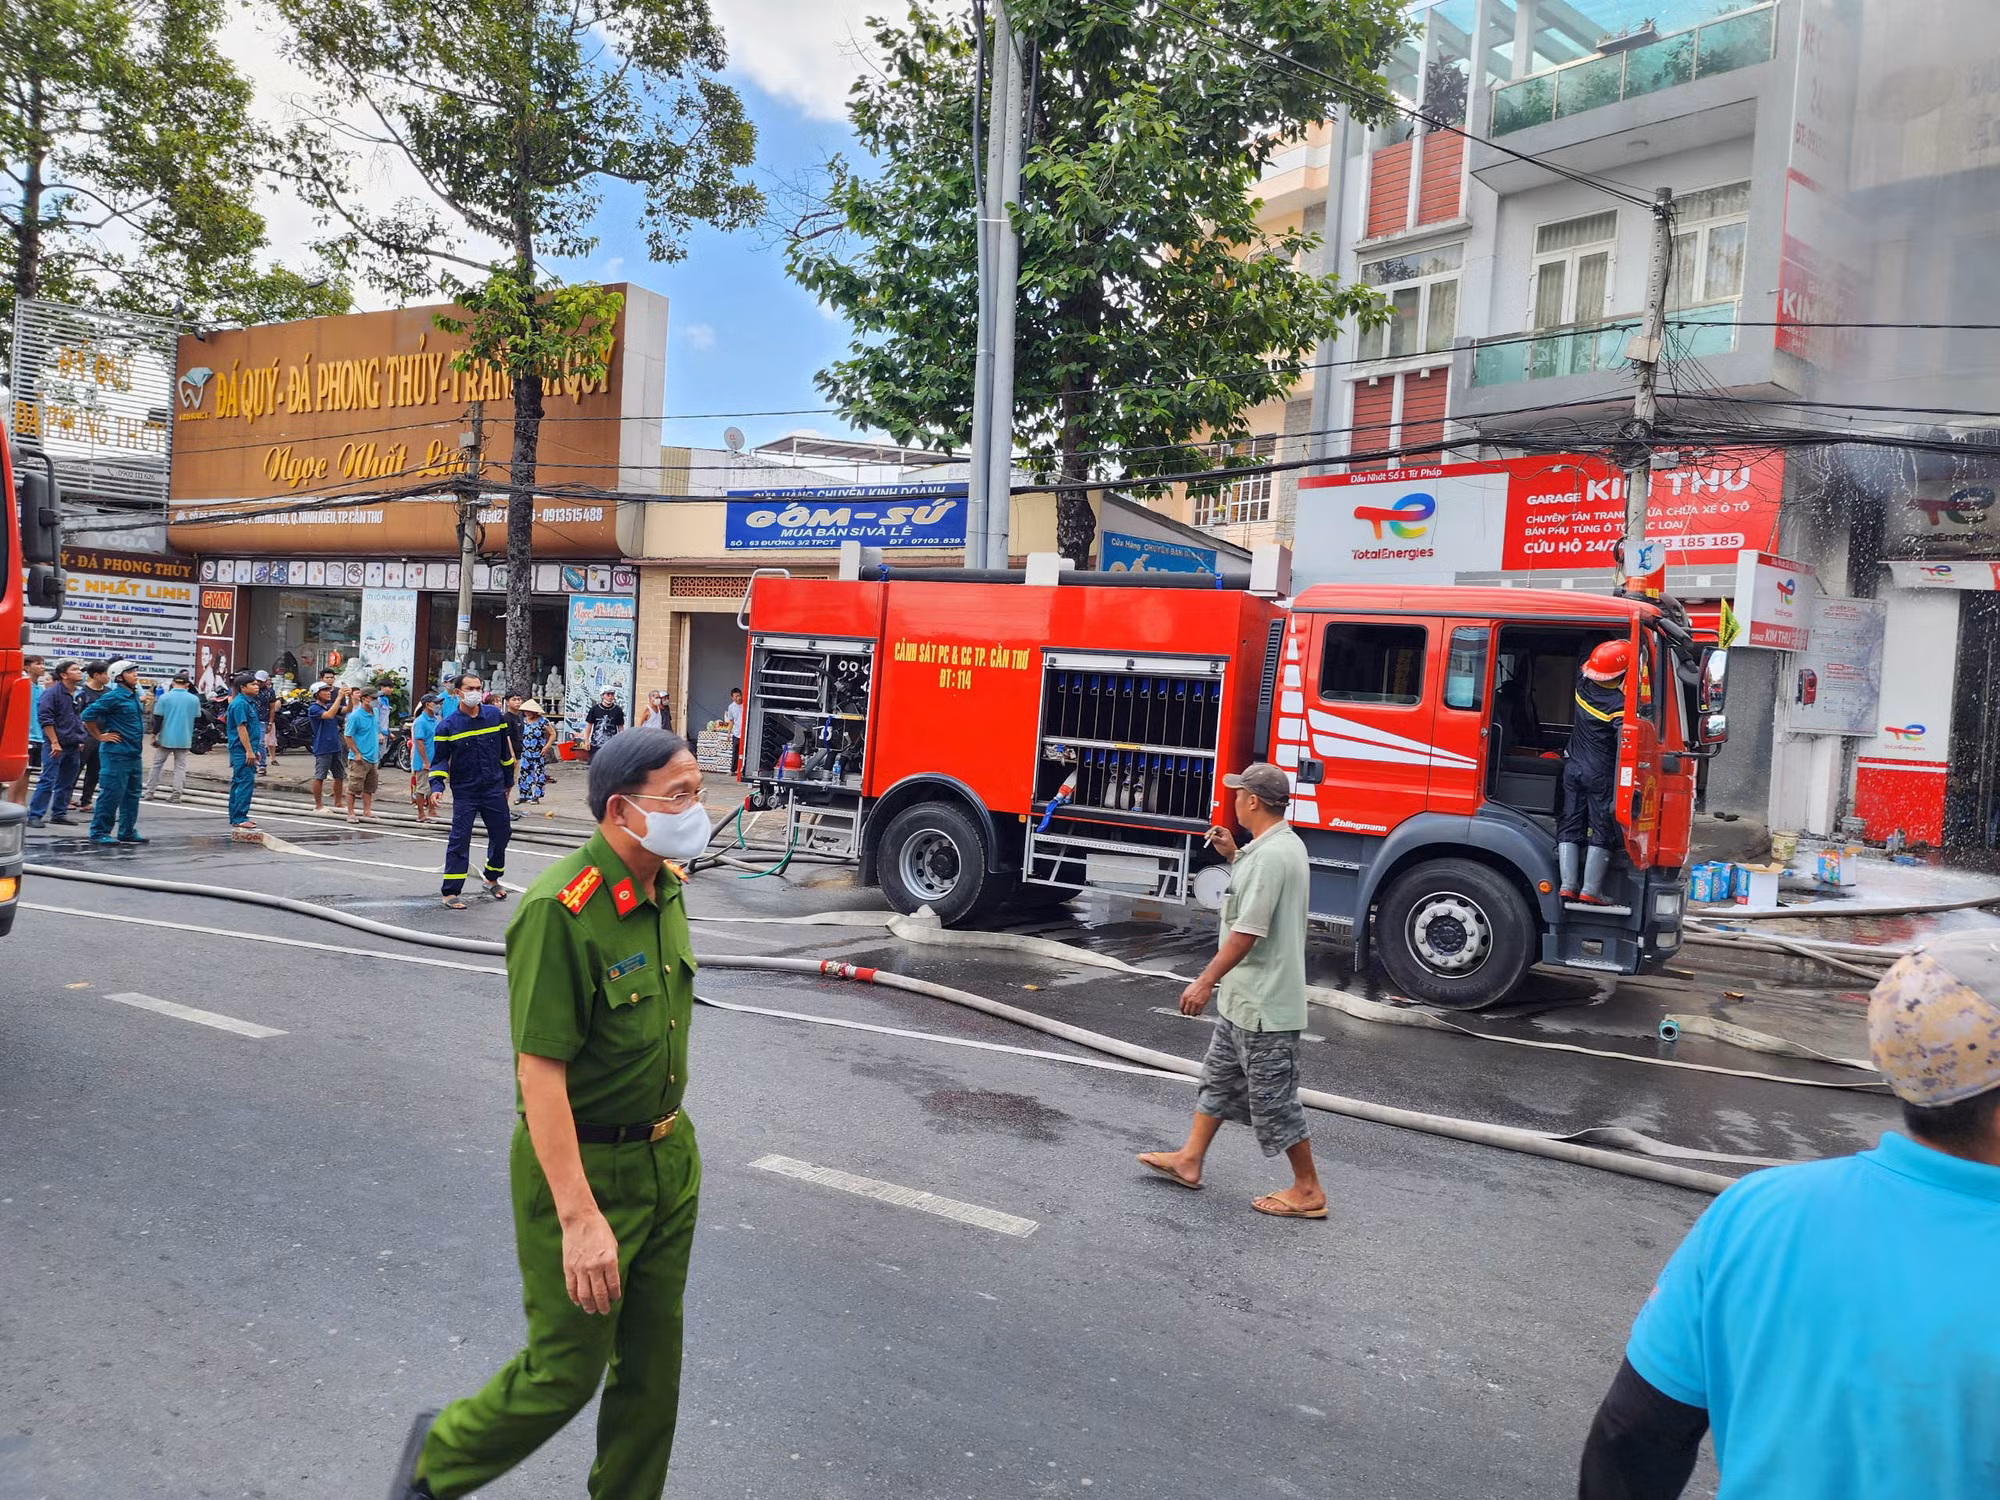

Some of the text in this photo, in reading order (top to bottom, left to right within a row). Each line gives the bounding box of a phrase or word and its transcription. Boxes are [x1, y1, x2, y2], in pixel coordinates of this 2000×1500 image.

[216, 359, 240, 419] ĐÁ
[241, 357, 280, 424] QUÝ
[287, 352, 312, 415] ĐÁ
[316, 356, 381, 412] PHONG
[386, 332, 443, 407] THỦY
[263, 445, 328, 488] Ngọc
[337, 442, 407, 479] Nhất
[1388, 470, 1399, 481] Số
[1420, 467, 1442, 479] Pháp
[1527, 493, 1581, 505] GARAGE
[1664, 465, 1751, 496] THU
[1720, 502, 1731, 512] Ô
[1732, 500, 1750, 512] TÔ
[367, 509, 384, 524] THƠ
[1526, 512, 1565, 524] CHUYÊN
[1571, 510, 1590, 521] TÂN
[781, 528, 813, 537] MUA
[815, 526, 848, 537] BÁN
[866, 525, 887, 536] VÀ
[1525, 526, 1546, 536] BÁN
[1548, 526, 1569, 536] PHỤ
[1572, 524, 1601, 534] TÙNG
[1603, 521, 1613, 532] Ô
[97, 533, 150, 549] YOGA
[1524, 539, 1555, 554] CỨU
[1558, 538, 1582, 554] HỘ
[1682, 539, 1706, 548] 185
[1712, 536, 1739, 547] 185
[1352, 546, 1434, 561] TotalEnergies
[77, 552, 98, 569] ĐÁ
[103, 557, 152, 574] PHONG
[154, 560, 192, 577] THỦY
[85, 578, 141, 596] NHẤT
[145, 584, 190, 601] LINH
[202, 590, 232, 609] GYM
[131, 605, 150, 613] PHONG
[203, 612, 229, 635] AV
[894, 636, 918, 662] CẢNH
[919, 641, 937, 664] SÁT
[938, 644, 950, 665] PC
[951, 646, 958, 665] &
[974, 647, 986, 667] TP.
[990, 642, 1010, 669] CẦN
[1012, 647, 1030, 670] THƠ
[957, 669, 972, 689] 114
[1328, 816, 1387, 832] Schlingmann
